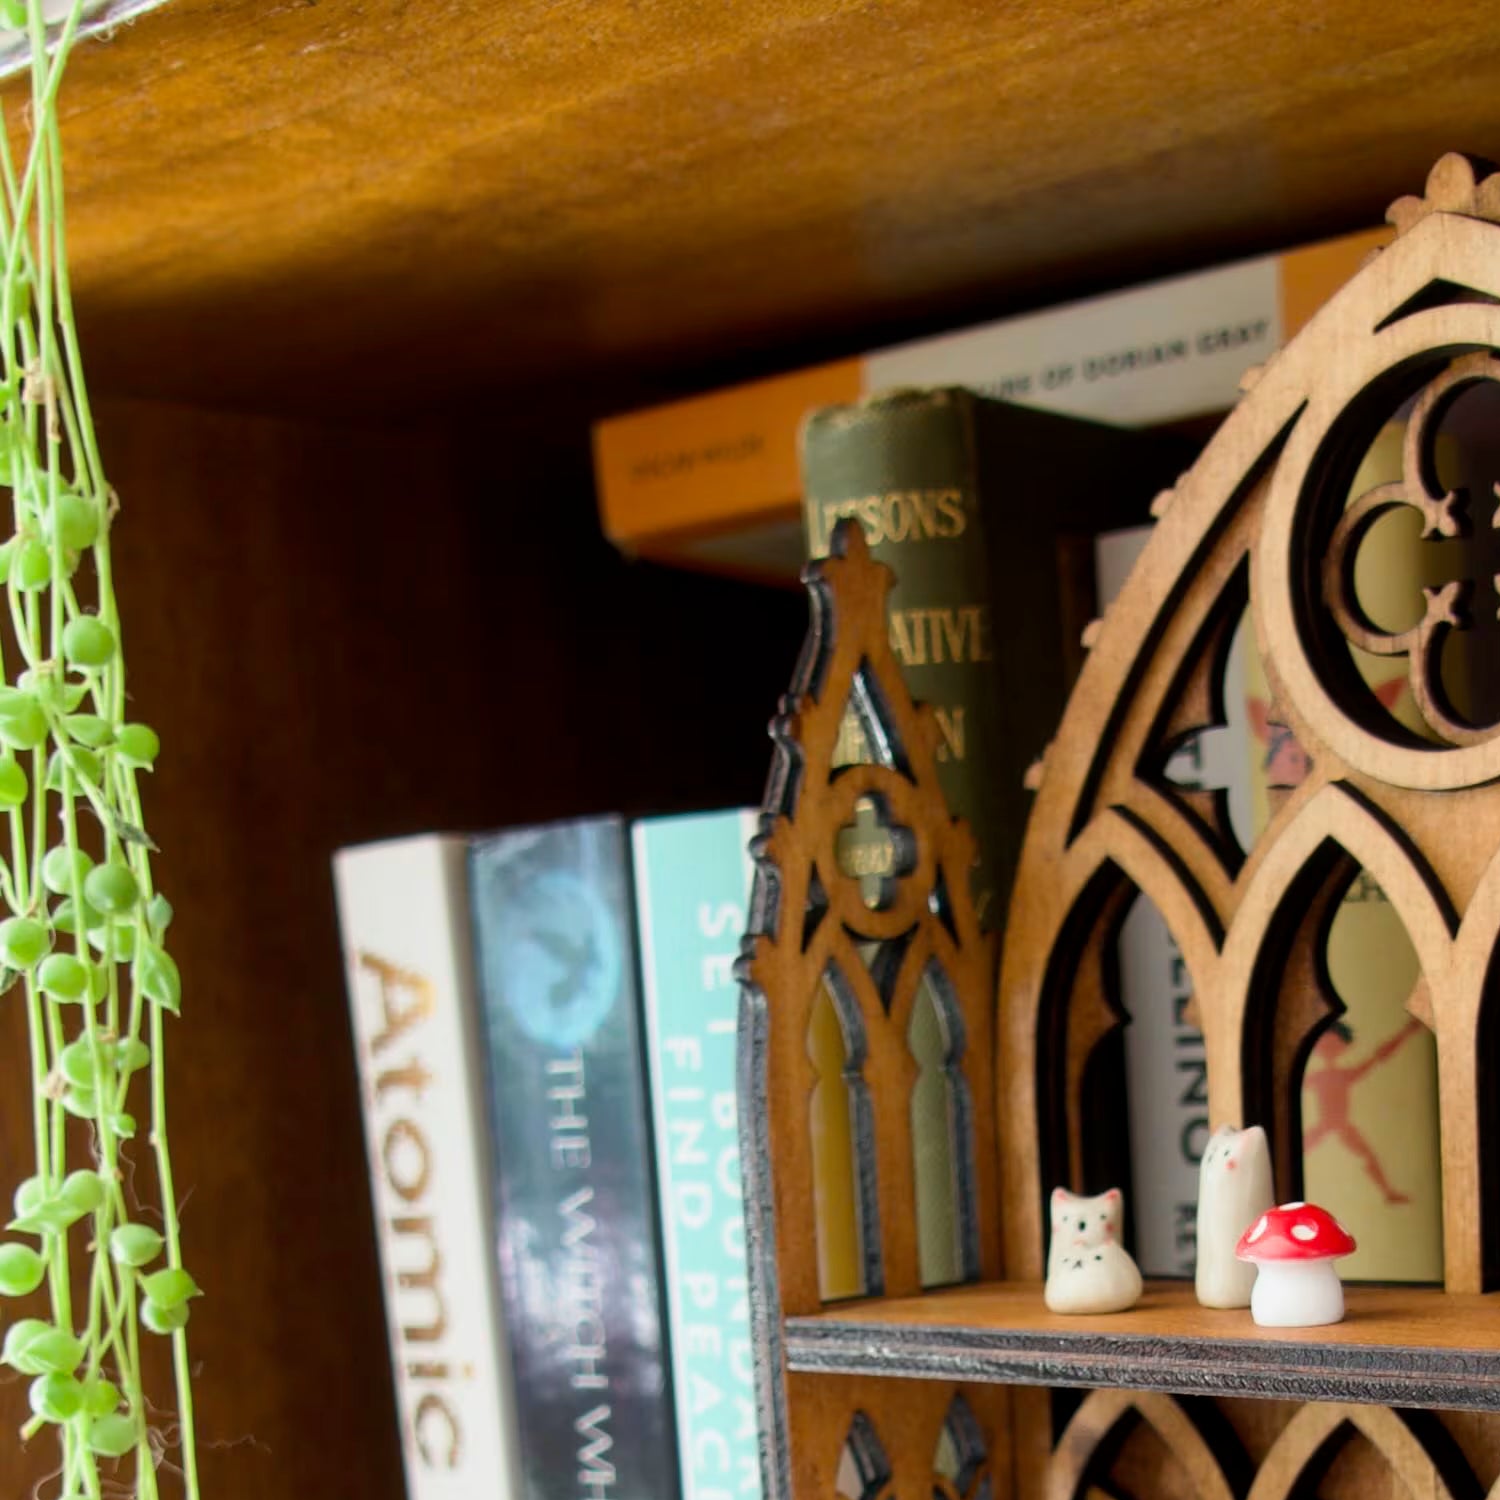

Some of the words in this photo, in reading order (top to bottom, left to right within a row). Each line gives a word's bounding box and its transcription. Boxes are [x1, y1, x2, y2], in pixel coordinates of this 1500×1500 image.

[1040, 363, 1075, 390] OF
[1081, 338, 1189, 386] DORIAN
[1195, 317, 1271, 357] GRAY
[809, 490, 967, 559] LSONS
[542, 1045, 591, 1168] THE
[663, 1033, 712, 1228] FIND
[359, 948, 472, 1475] Atomic
